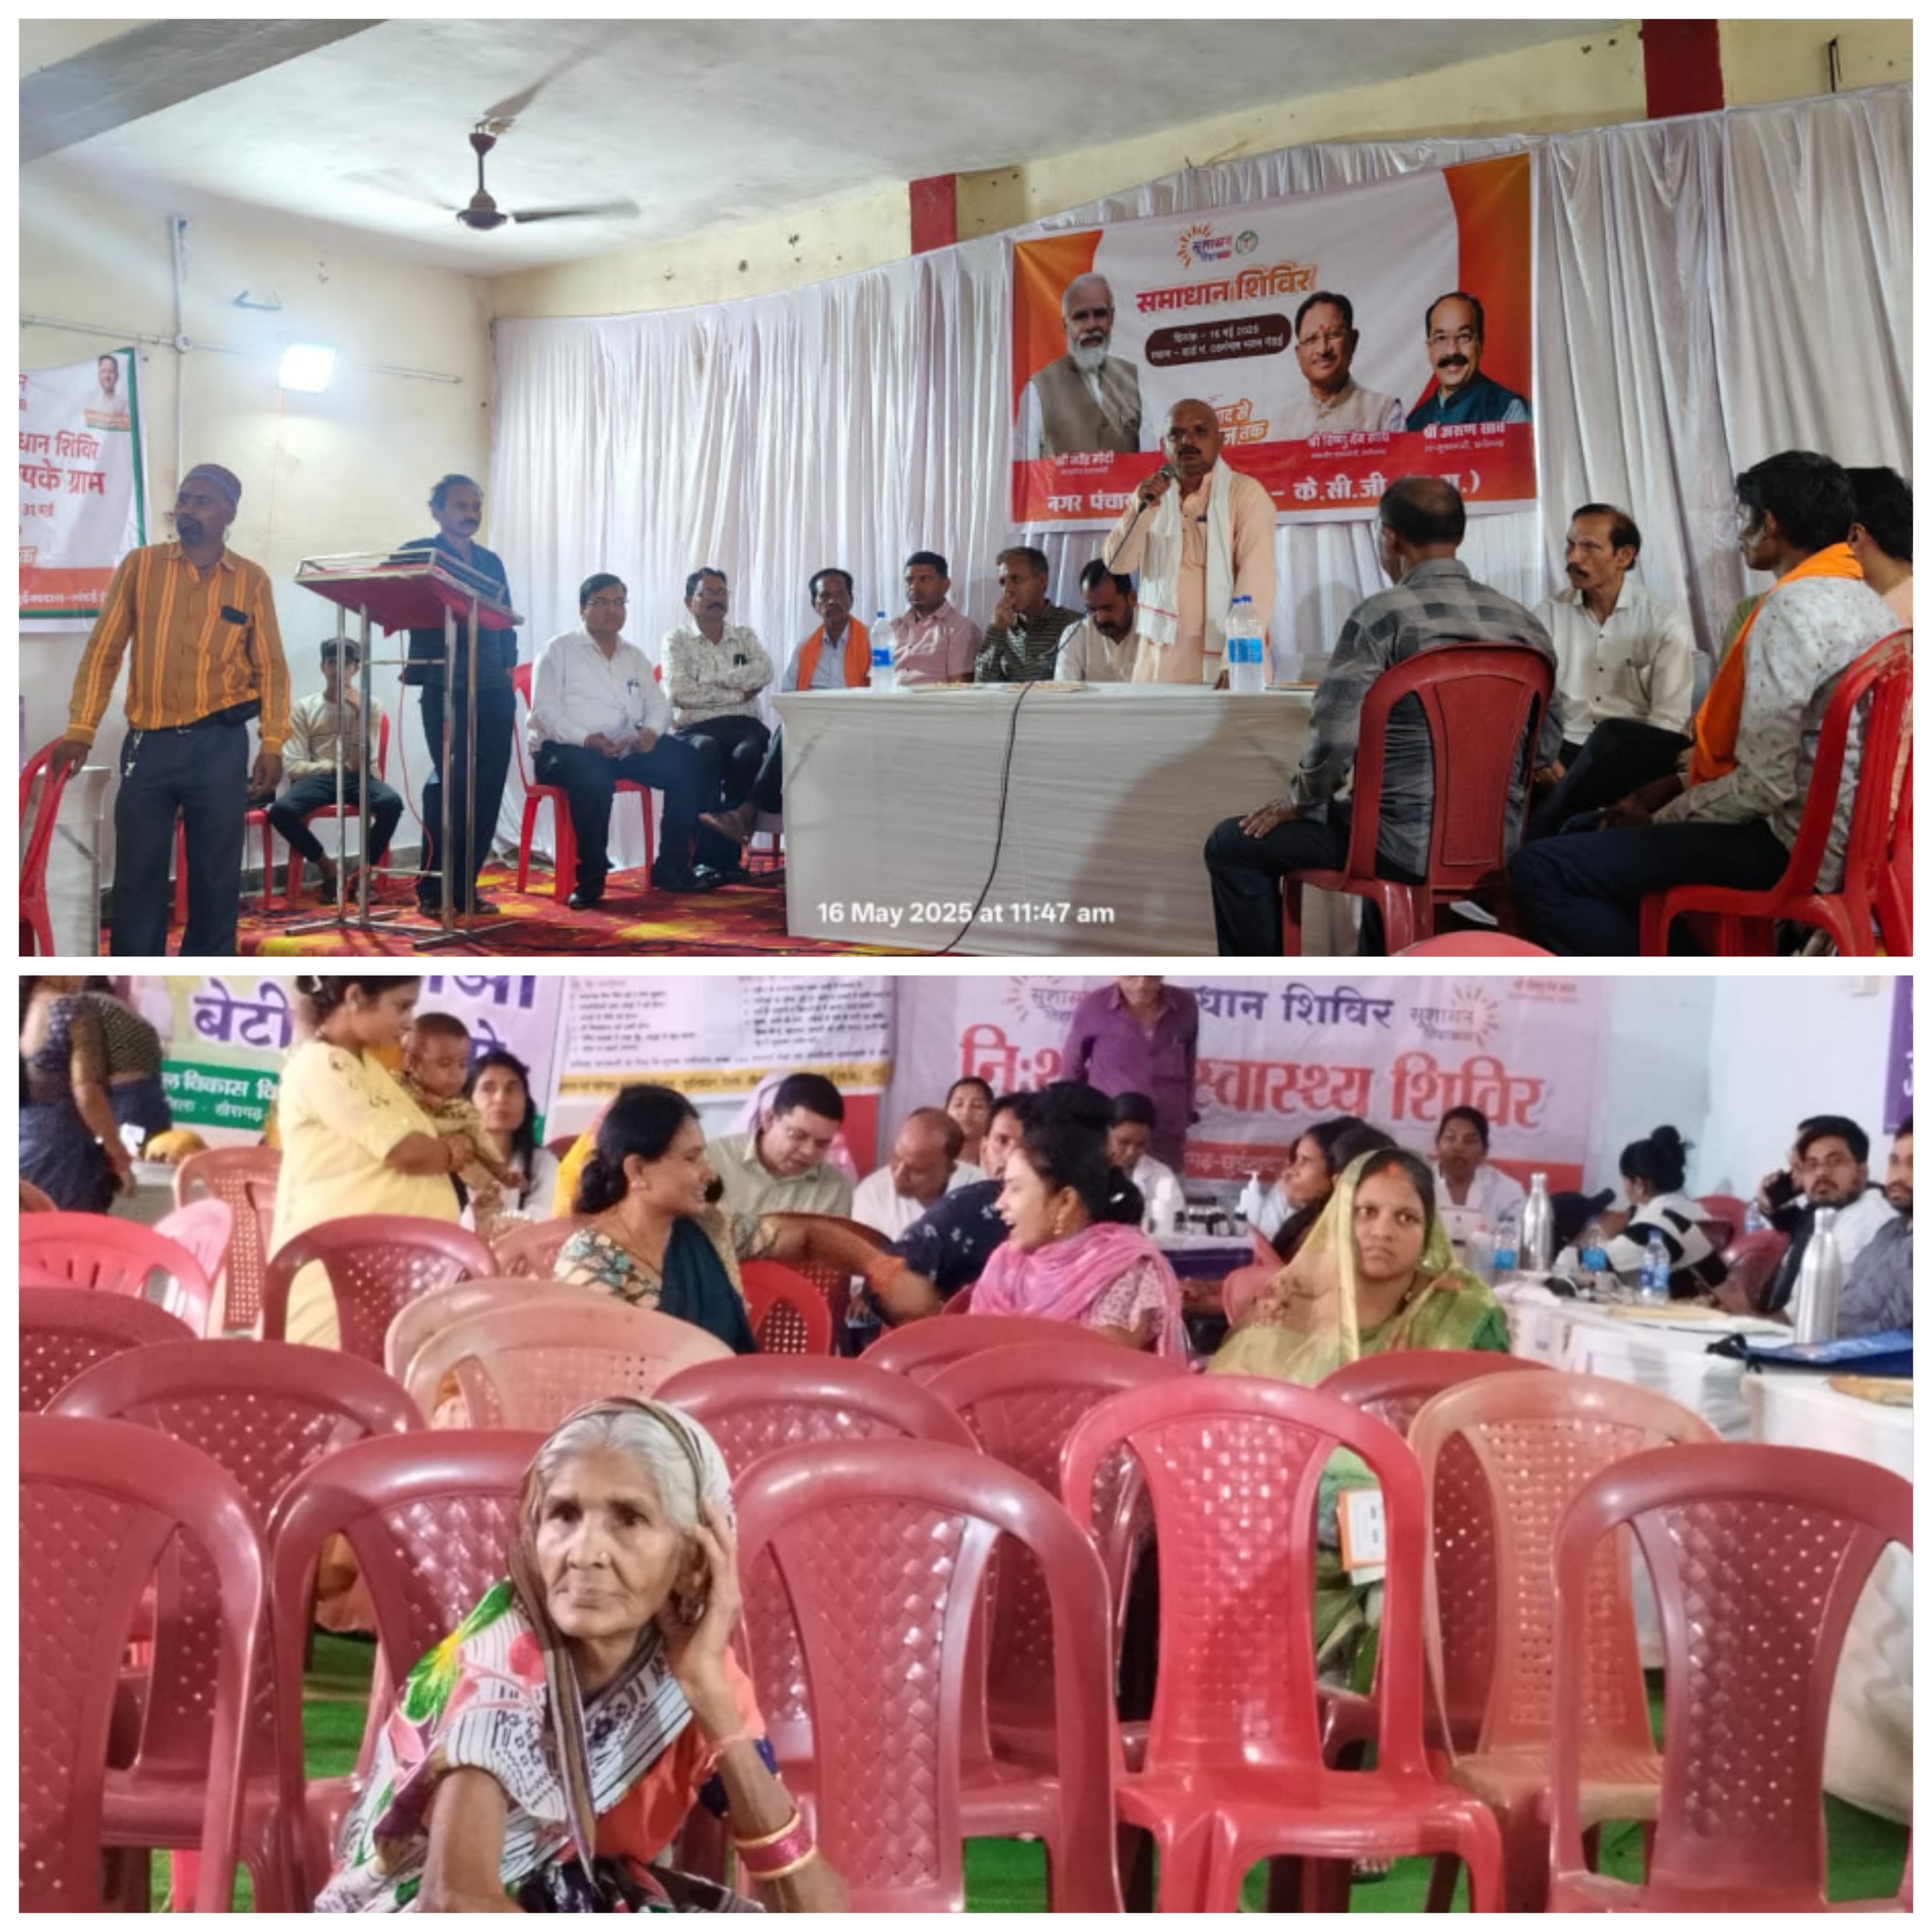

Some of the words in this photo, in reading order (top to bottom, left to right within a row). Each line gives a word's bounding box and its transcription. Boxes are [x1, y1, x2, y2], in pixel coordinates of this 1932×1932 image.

[1136, 279, 1230, 313] समाधान
[1233, 261, 1316, 301] शिविर
[55, 430, 100, 460] शिविर
[1092, 450, 1114, 464] मोदी
[19, 458, 63, 491] पके
[67, 469, 107, 496] ग्राम
[1047, 494, 1084, 512] नगर
[1090, 488, 1135, 510] पंचा
[193, 977, 293, 1049] बेटी
[1281, 982, 1395, 1030] शिविर
[182, 1068, 250, 1099] विकास
[1390, 1050, 1547, 1131] शिविर
